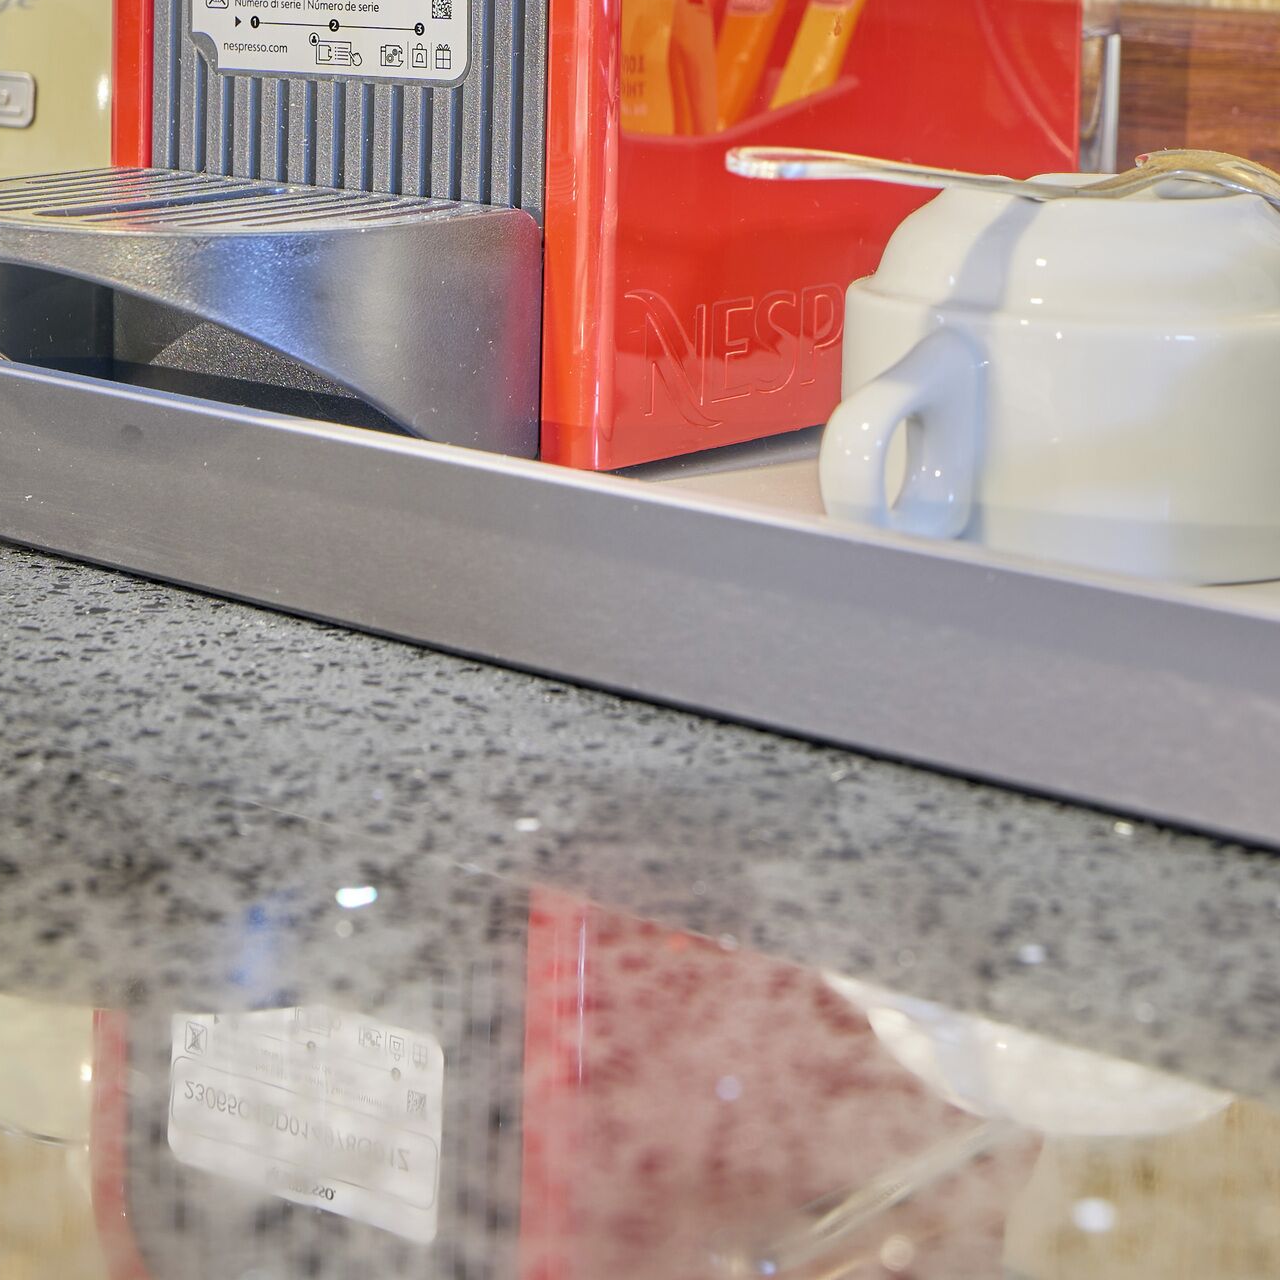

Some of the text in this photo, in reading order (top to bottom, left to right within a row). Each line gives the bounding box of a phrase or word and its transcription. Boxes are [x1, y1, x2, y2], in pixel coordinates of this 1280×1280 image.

[307, 0, 344, 11] Número
[344, 1, 357, 12] de
[358, 2, 380, 13] serie
[223, 41, 288, 54] nespresso.com
